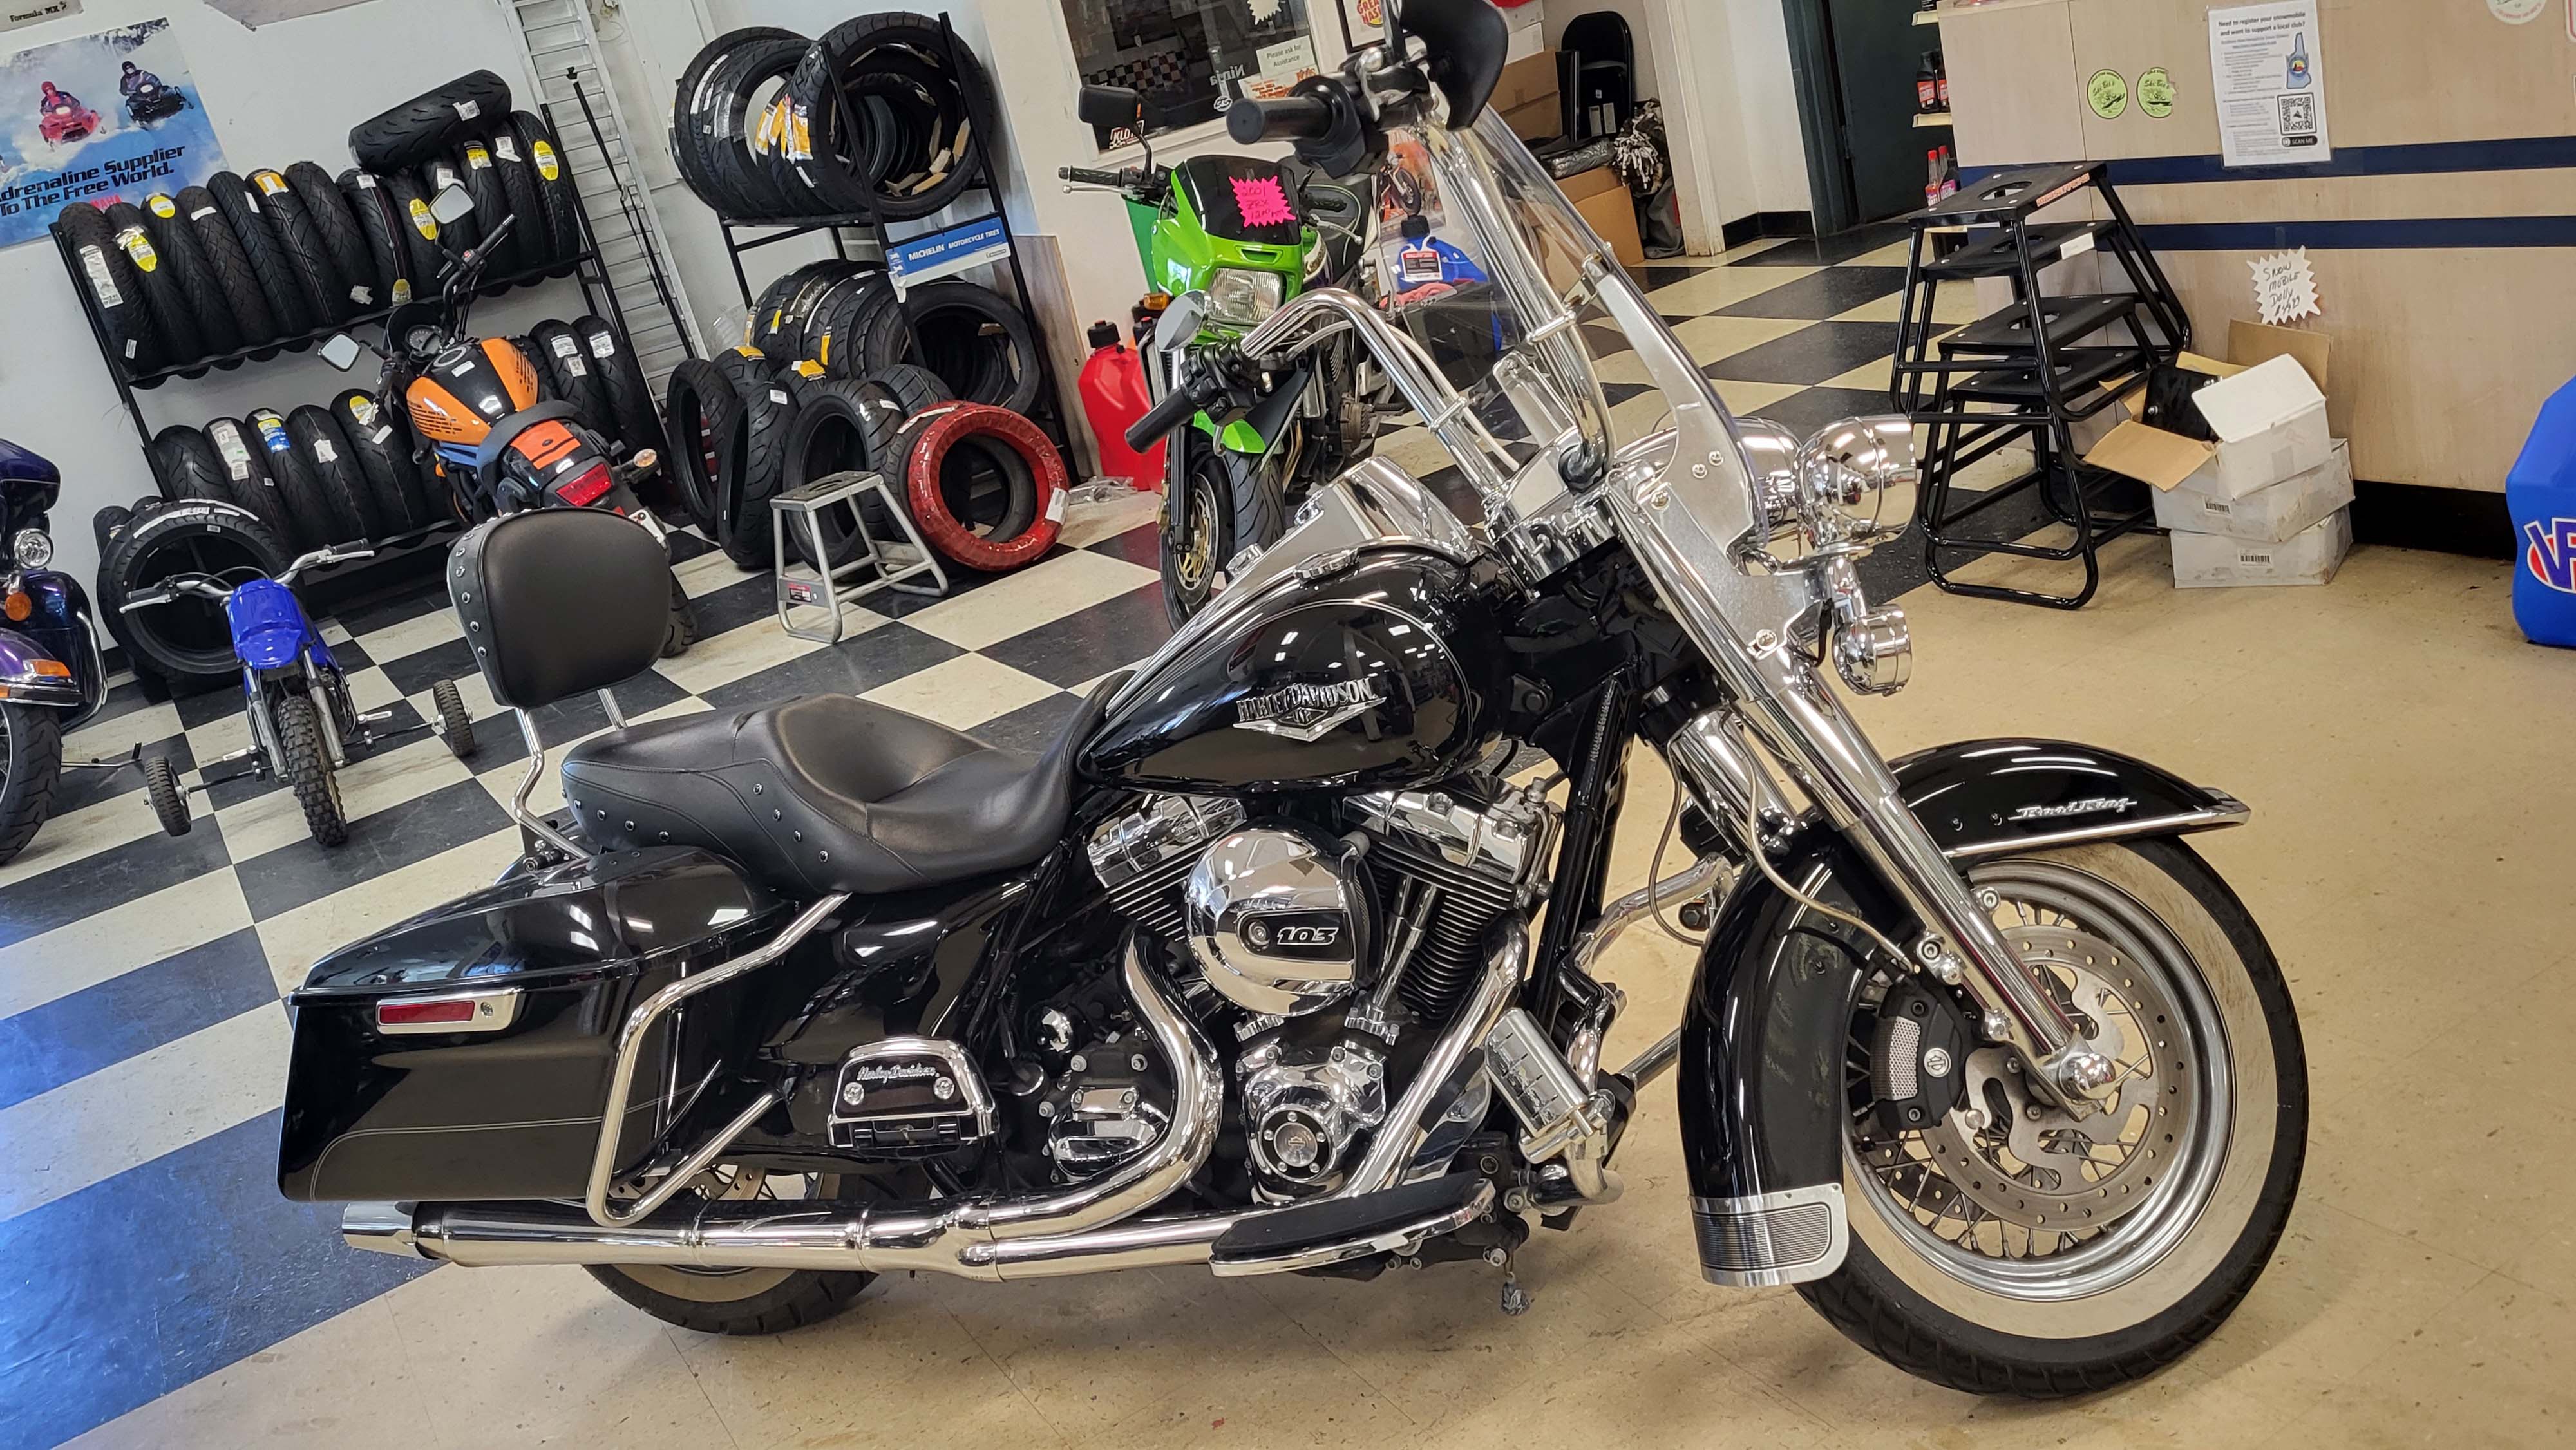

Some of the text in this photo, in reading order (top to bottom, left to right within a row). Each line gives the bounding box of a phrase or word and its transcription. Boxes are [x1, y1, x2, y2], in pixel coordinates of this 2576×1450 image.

[9, 10, 43, 22] Formula
[44, 5, 60, 14] MX
[2240, 17, 2259, 26] register
[2273, 12, 2306, 21] snowmobile
[2251, 26, 2272, 34] support
[1267, 47, 1284, 59] Please
[1294, 44, 1302, 52] for
[1273, 55, 1300, 68] Assistance
[0, 146, 185, 202] drenaline Supplier
[0, 162, 175, 216] To The Free World.
[908, 243, 945, 262] MICHELIN
[948, 232, 985, 249] MOTORCYCLE
[985, 228, 1000, 239] TIRES
[1276, 927, 1340, 946] 103
